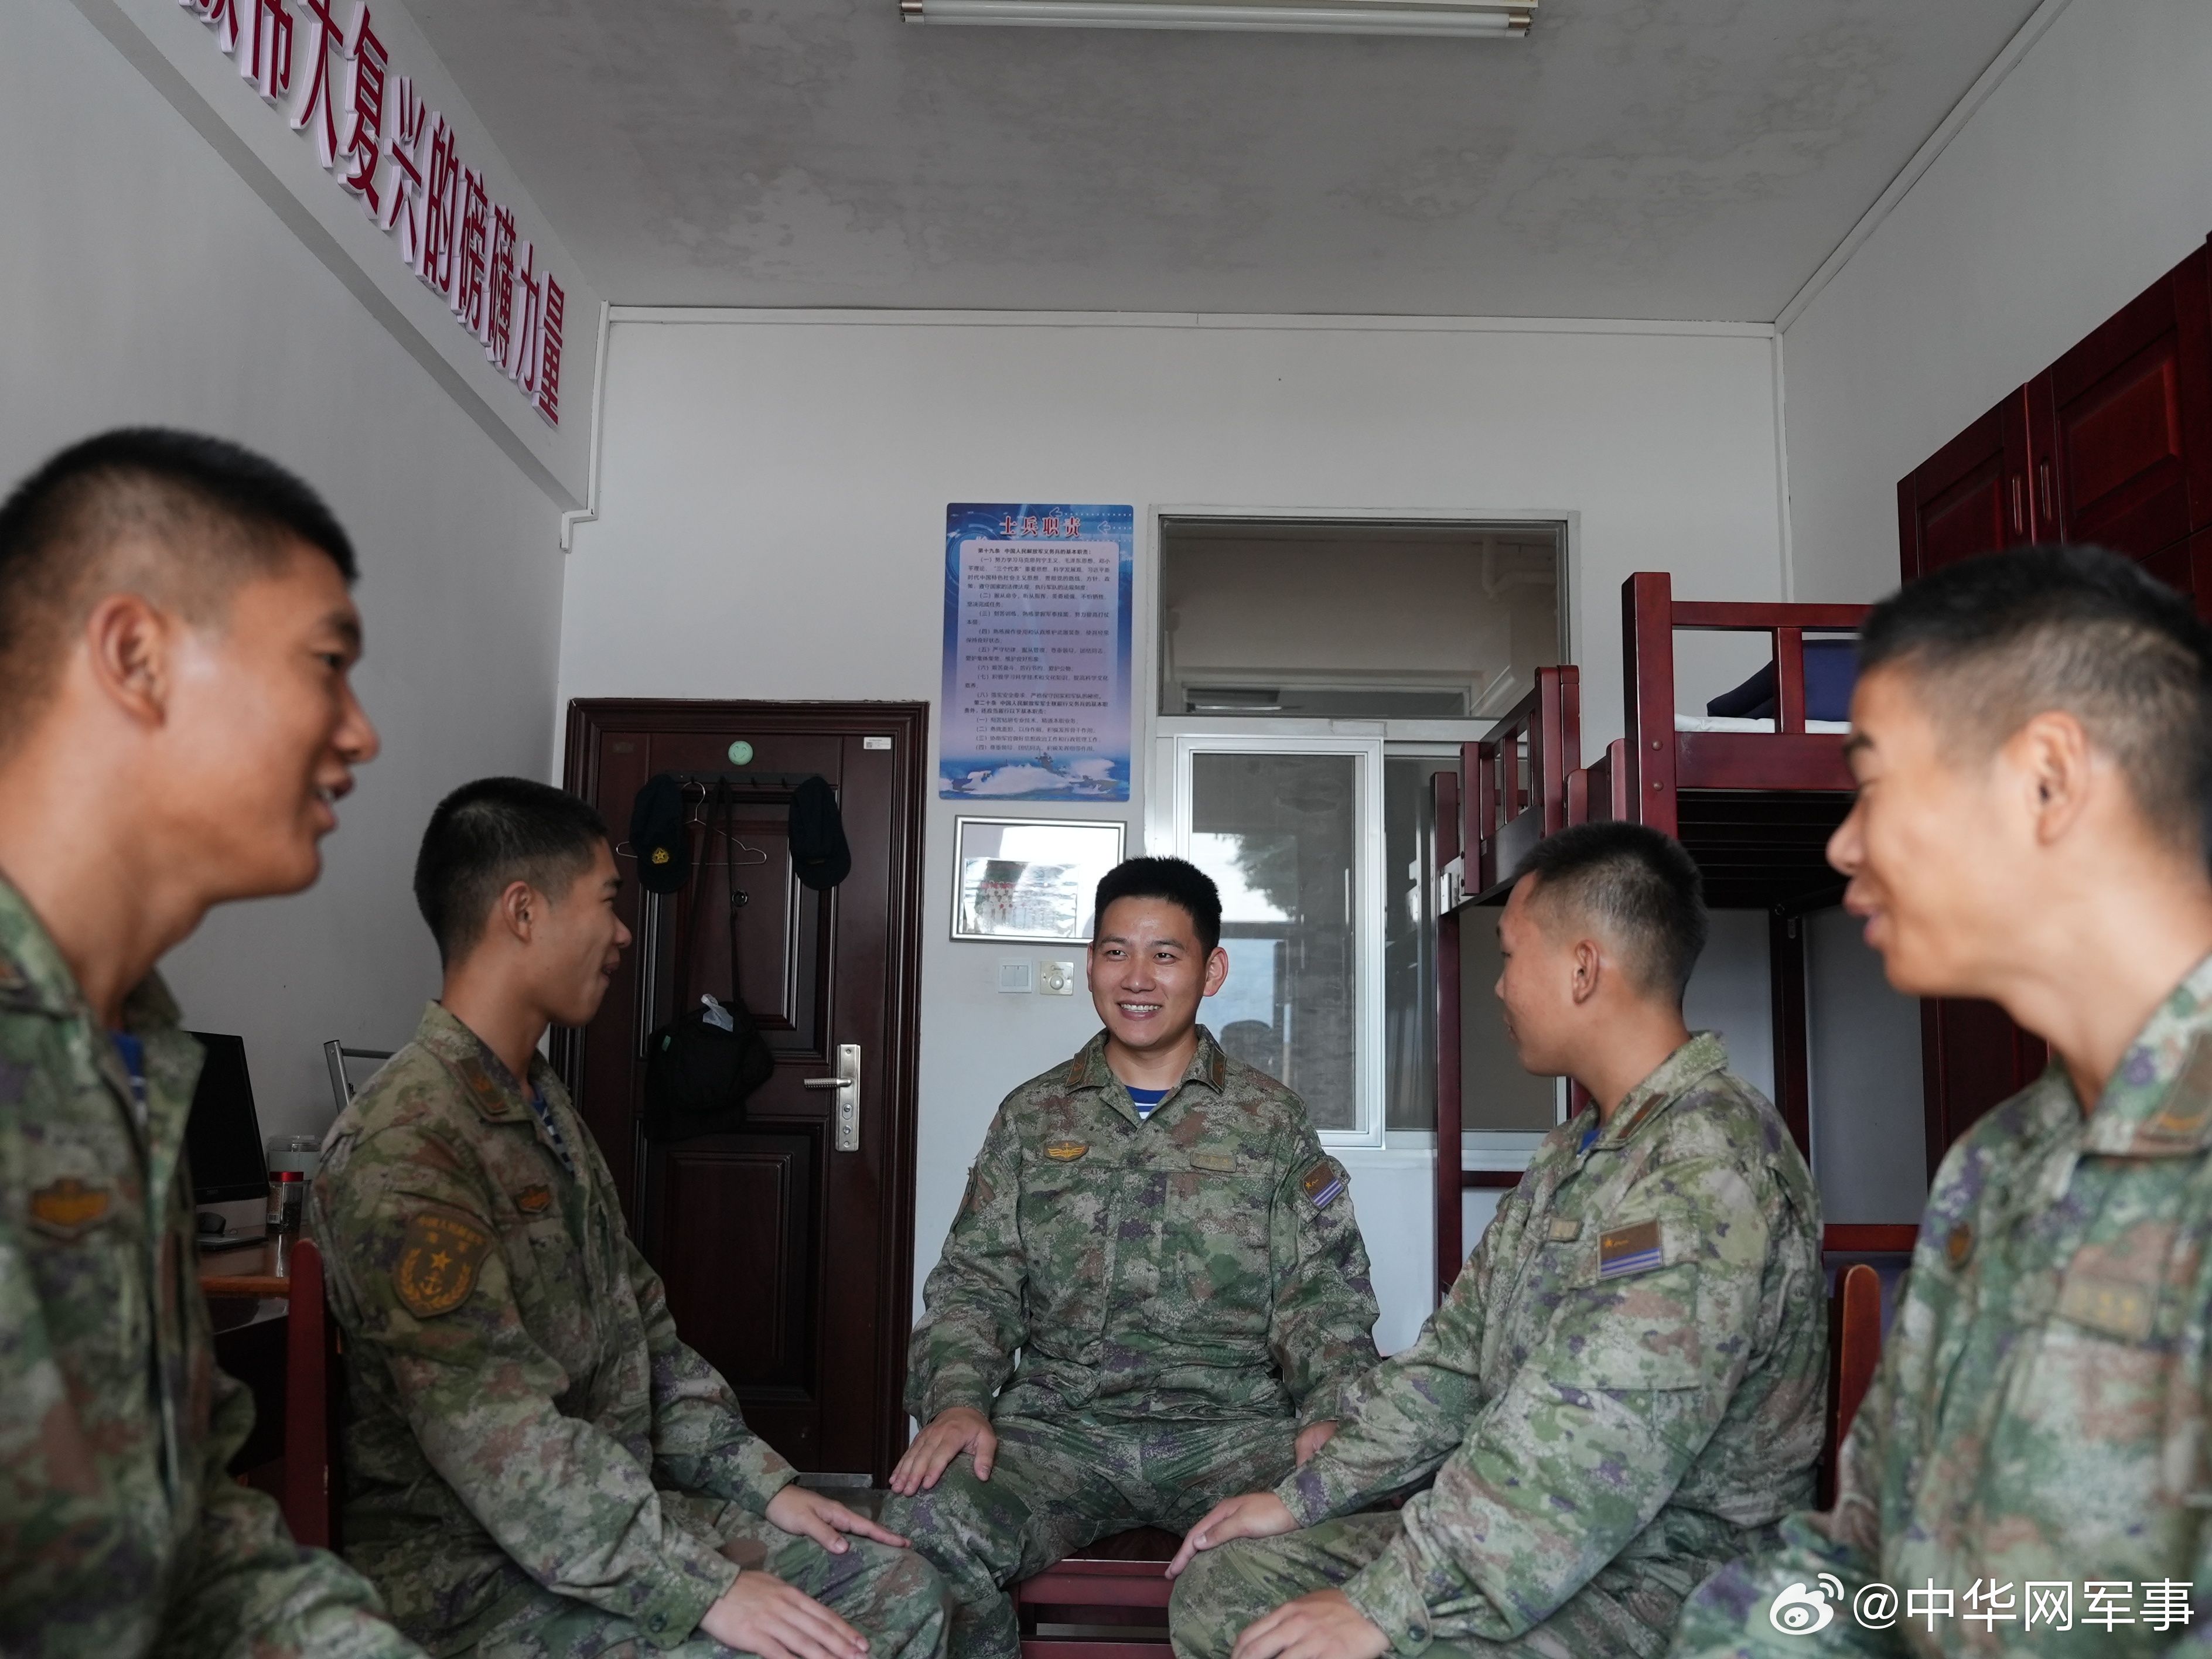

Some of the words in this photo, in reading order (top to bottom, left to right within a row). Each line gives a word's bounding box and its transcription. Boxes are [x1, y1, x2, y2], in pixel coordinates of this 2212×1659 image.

[179, 0, 565, 428] 大复兴的磅礴力量
[999, 516, 1081, 538] 士兵职责
